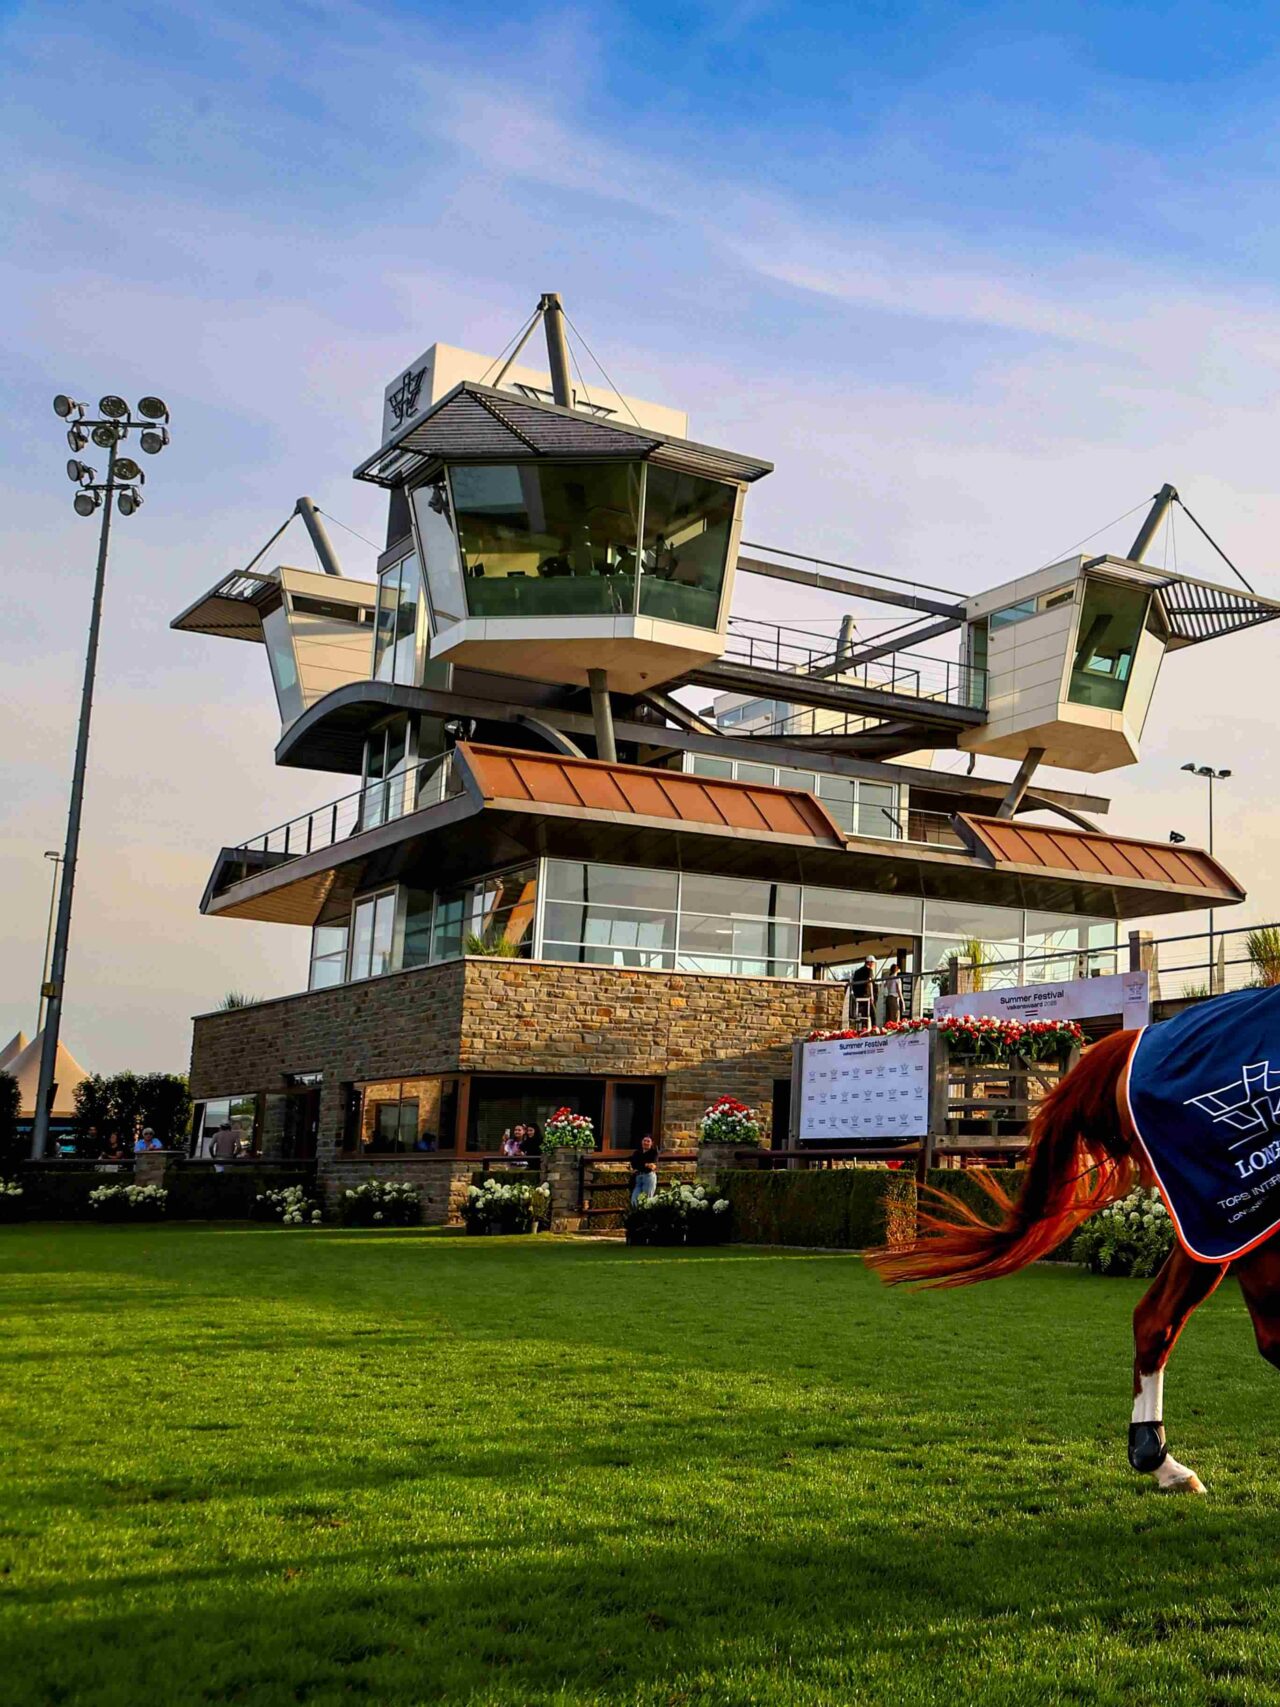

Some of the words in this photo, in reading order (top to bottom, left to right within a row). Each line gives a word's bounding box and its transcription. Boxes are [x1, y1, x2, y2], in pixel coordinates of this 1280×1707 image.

[1000, 995, 1031, 1004] Summer
[1034, 990, 1064, 1001] Festival
[839, 1043, 863, 1051] Summer
[865, 1039, 889, 1048] Festival
[1216, 1191, 1251, 1209] TOPS
